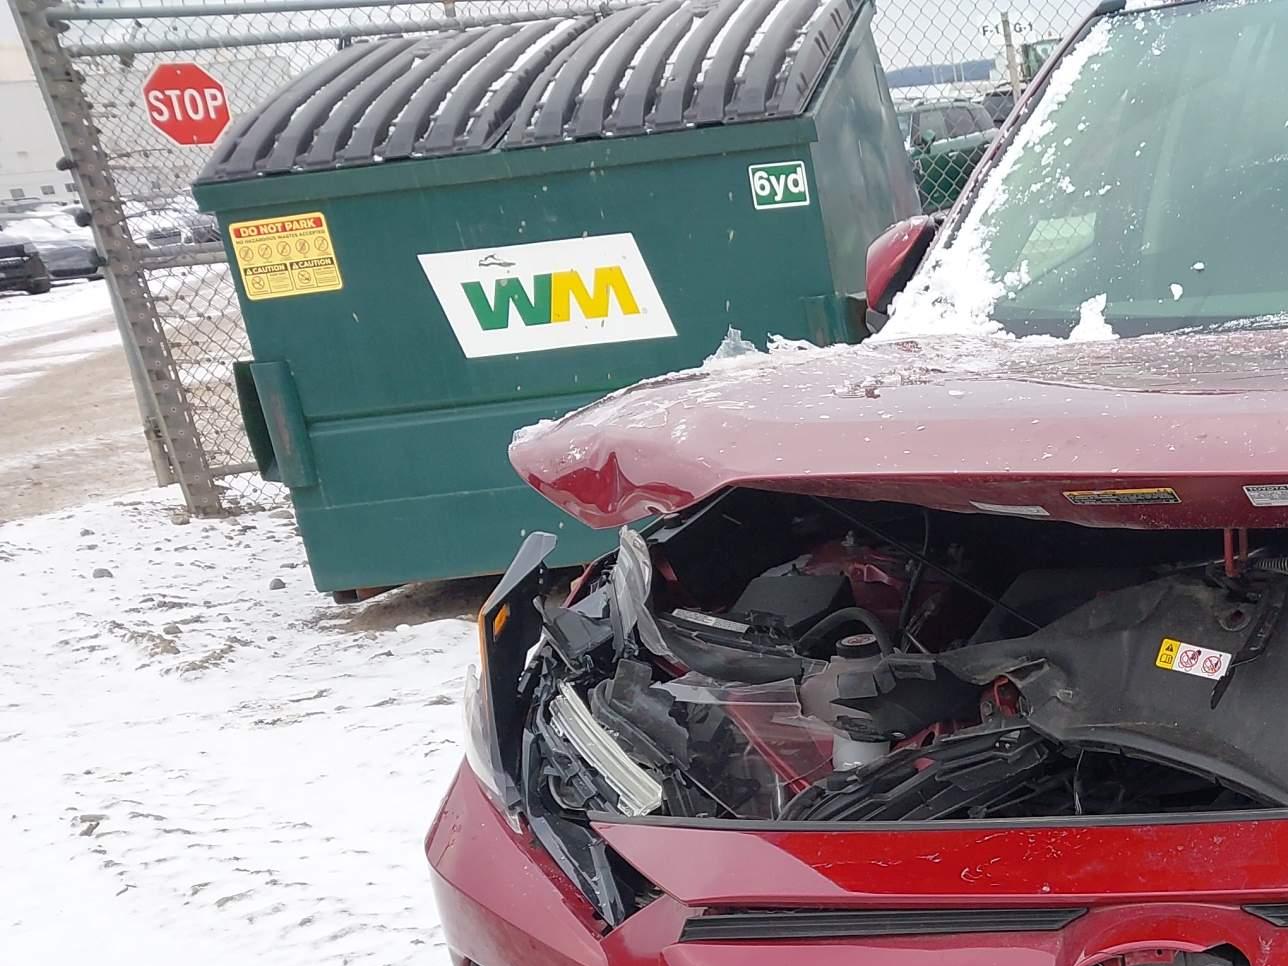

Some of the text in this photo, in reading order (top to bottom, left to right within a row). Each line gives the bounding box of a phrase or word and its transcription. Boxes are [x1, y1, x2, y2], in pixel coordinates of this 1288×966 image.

[147, 88, 223, 122] STOP
[753, 166, 805, 201] 6yd
[240, 218, 316, 236] DO NOT PARK
[253, 265, 285, 273] CAUTION
[299, 258, 332, 269] CAUTION
[460, 265, 641, 331] WM
